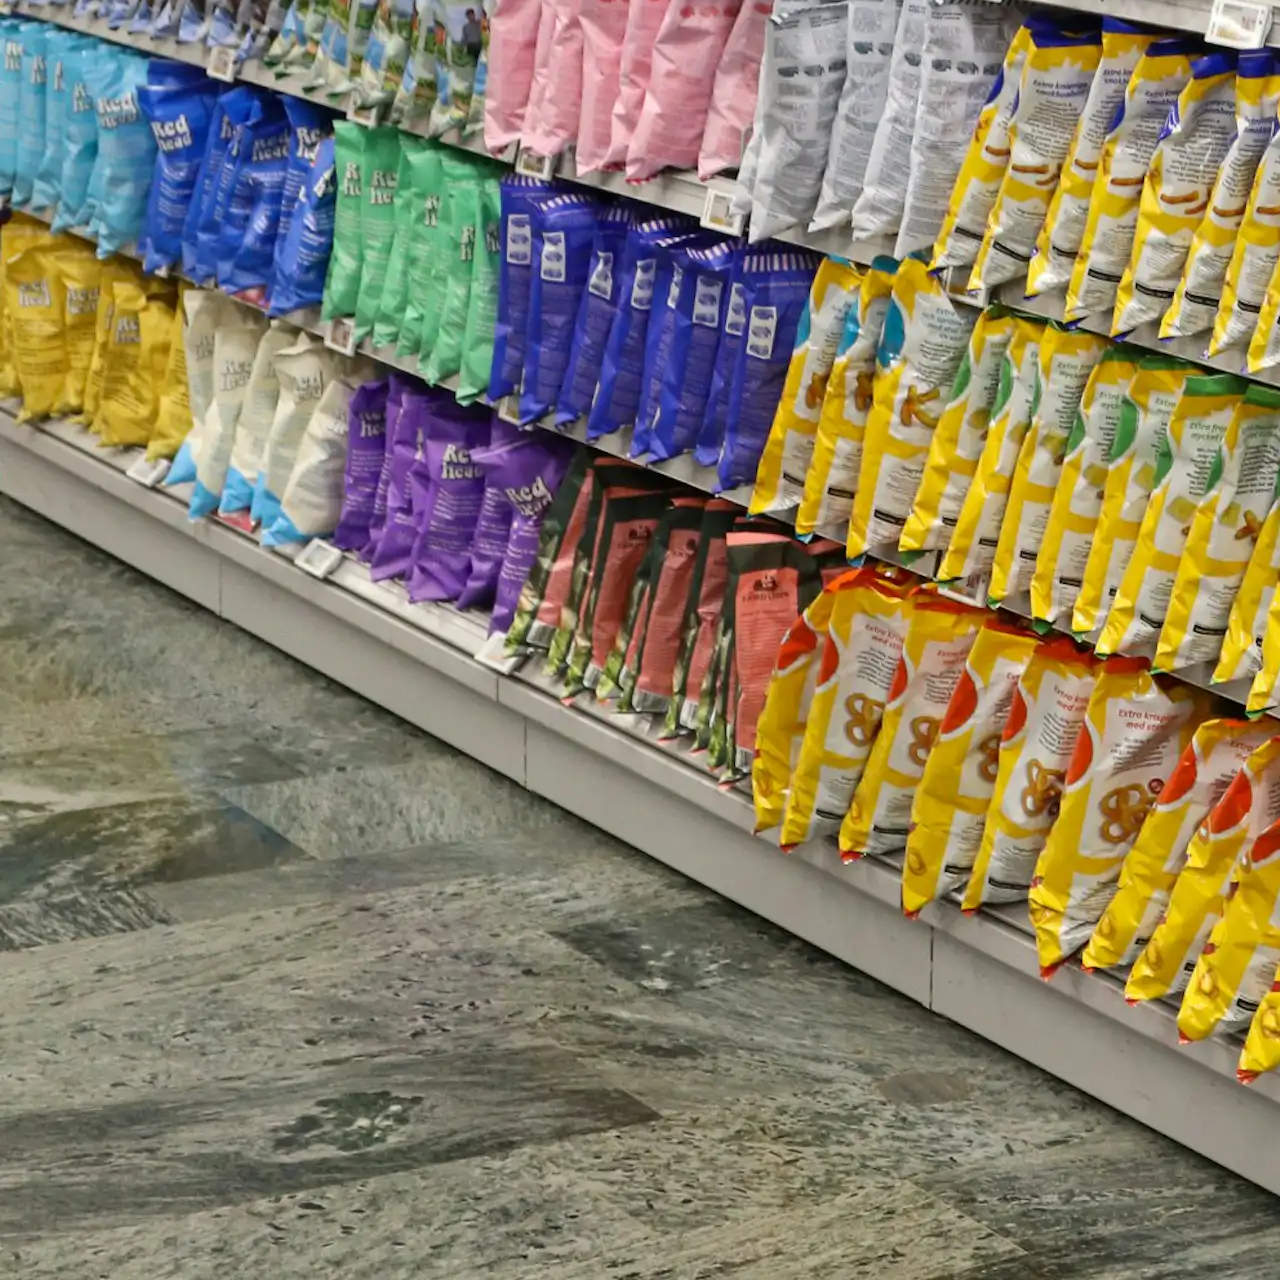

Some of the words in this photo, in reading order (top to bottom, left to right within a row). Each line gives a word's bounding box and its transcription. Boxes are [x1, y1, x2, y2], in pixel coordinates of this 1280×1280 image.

[151, 114, 189, 138] Red
[157, 131, 192, 154] head
[505, 476, 545, 505] Red
[865, 624, 887, 637] Extra
[1053, 685, 1073, 702] Extra
[1118, 708, 1141, 720] Extra
[1126, 720, 1144, 730] med
